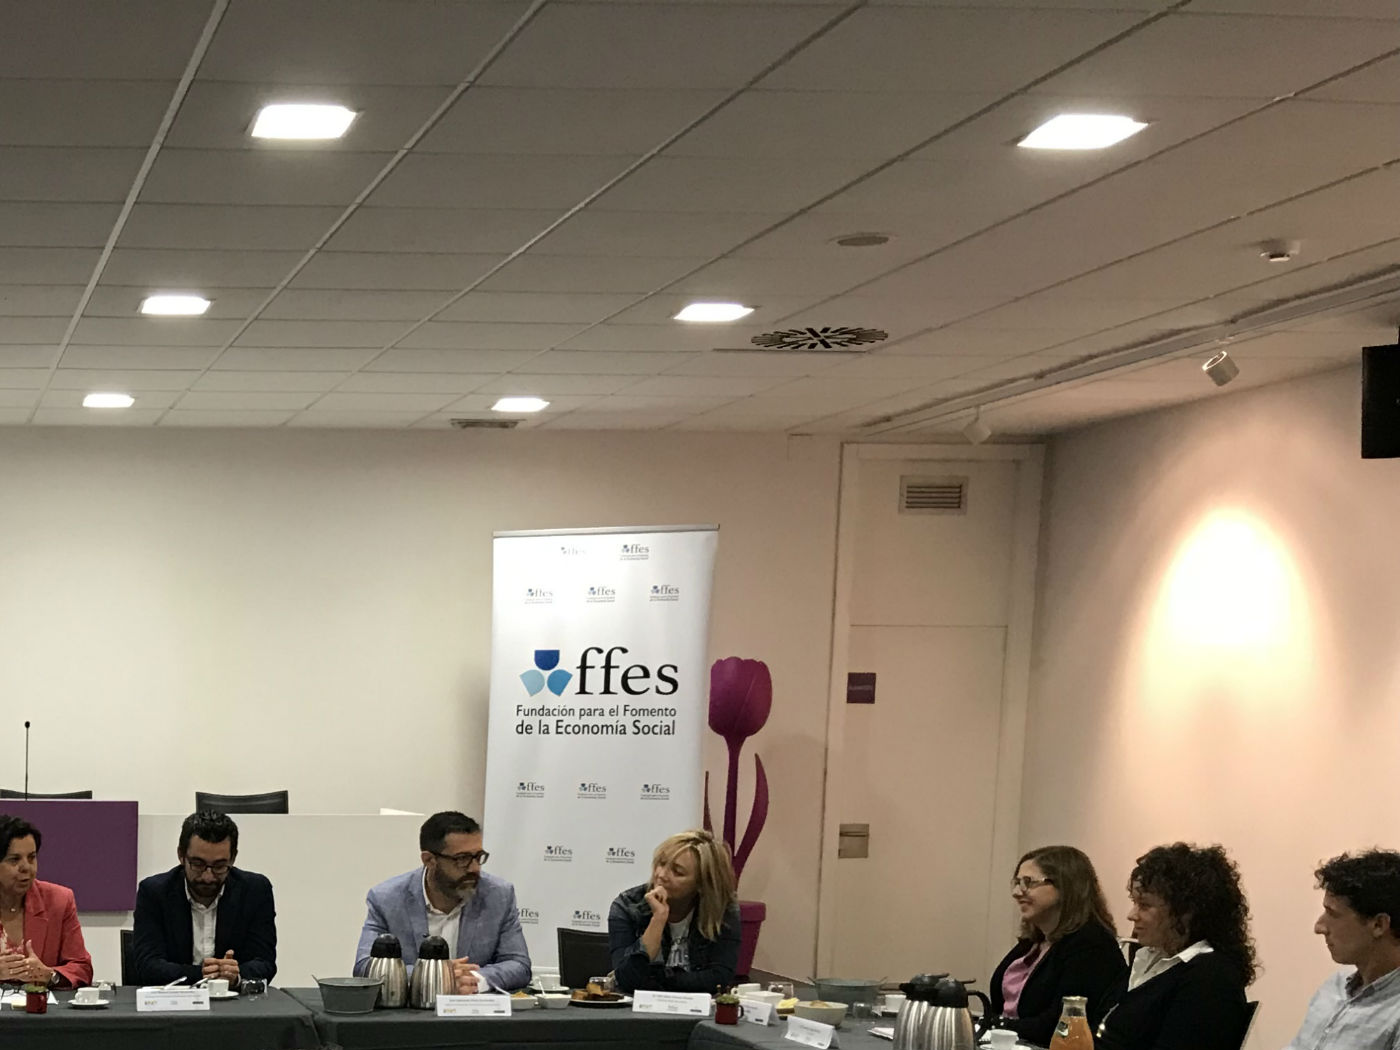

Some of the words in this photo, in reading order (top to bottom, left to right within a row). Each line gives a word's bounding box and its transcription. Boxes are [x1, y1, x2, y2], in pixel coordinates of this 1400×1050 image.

[574, 646, 679, 696] ffes
[516, 704, 576, 718] Fundación
[578, 707, 606, 720] para
[608, 704, 620, 718] el
[623, 704, 677, 718] Fomento
[515, 719, 534, 736] de
[538, 719, 551, 736] la
[555, 719, 628, 736] Economía
[632, 719, 676, 736] Social
